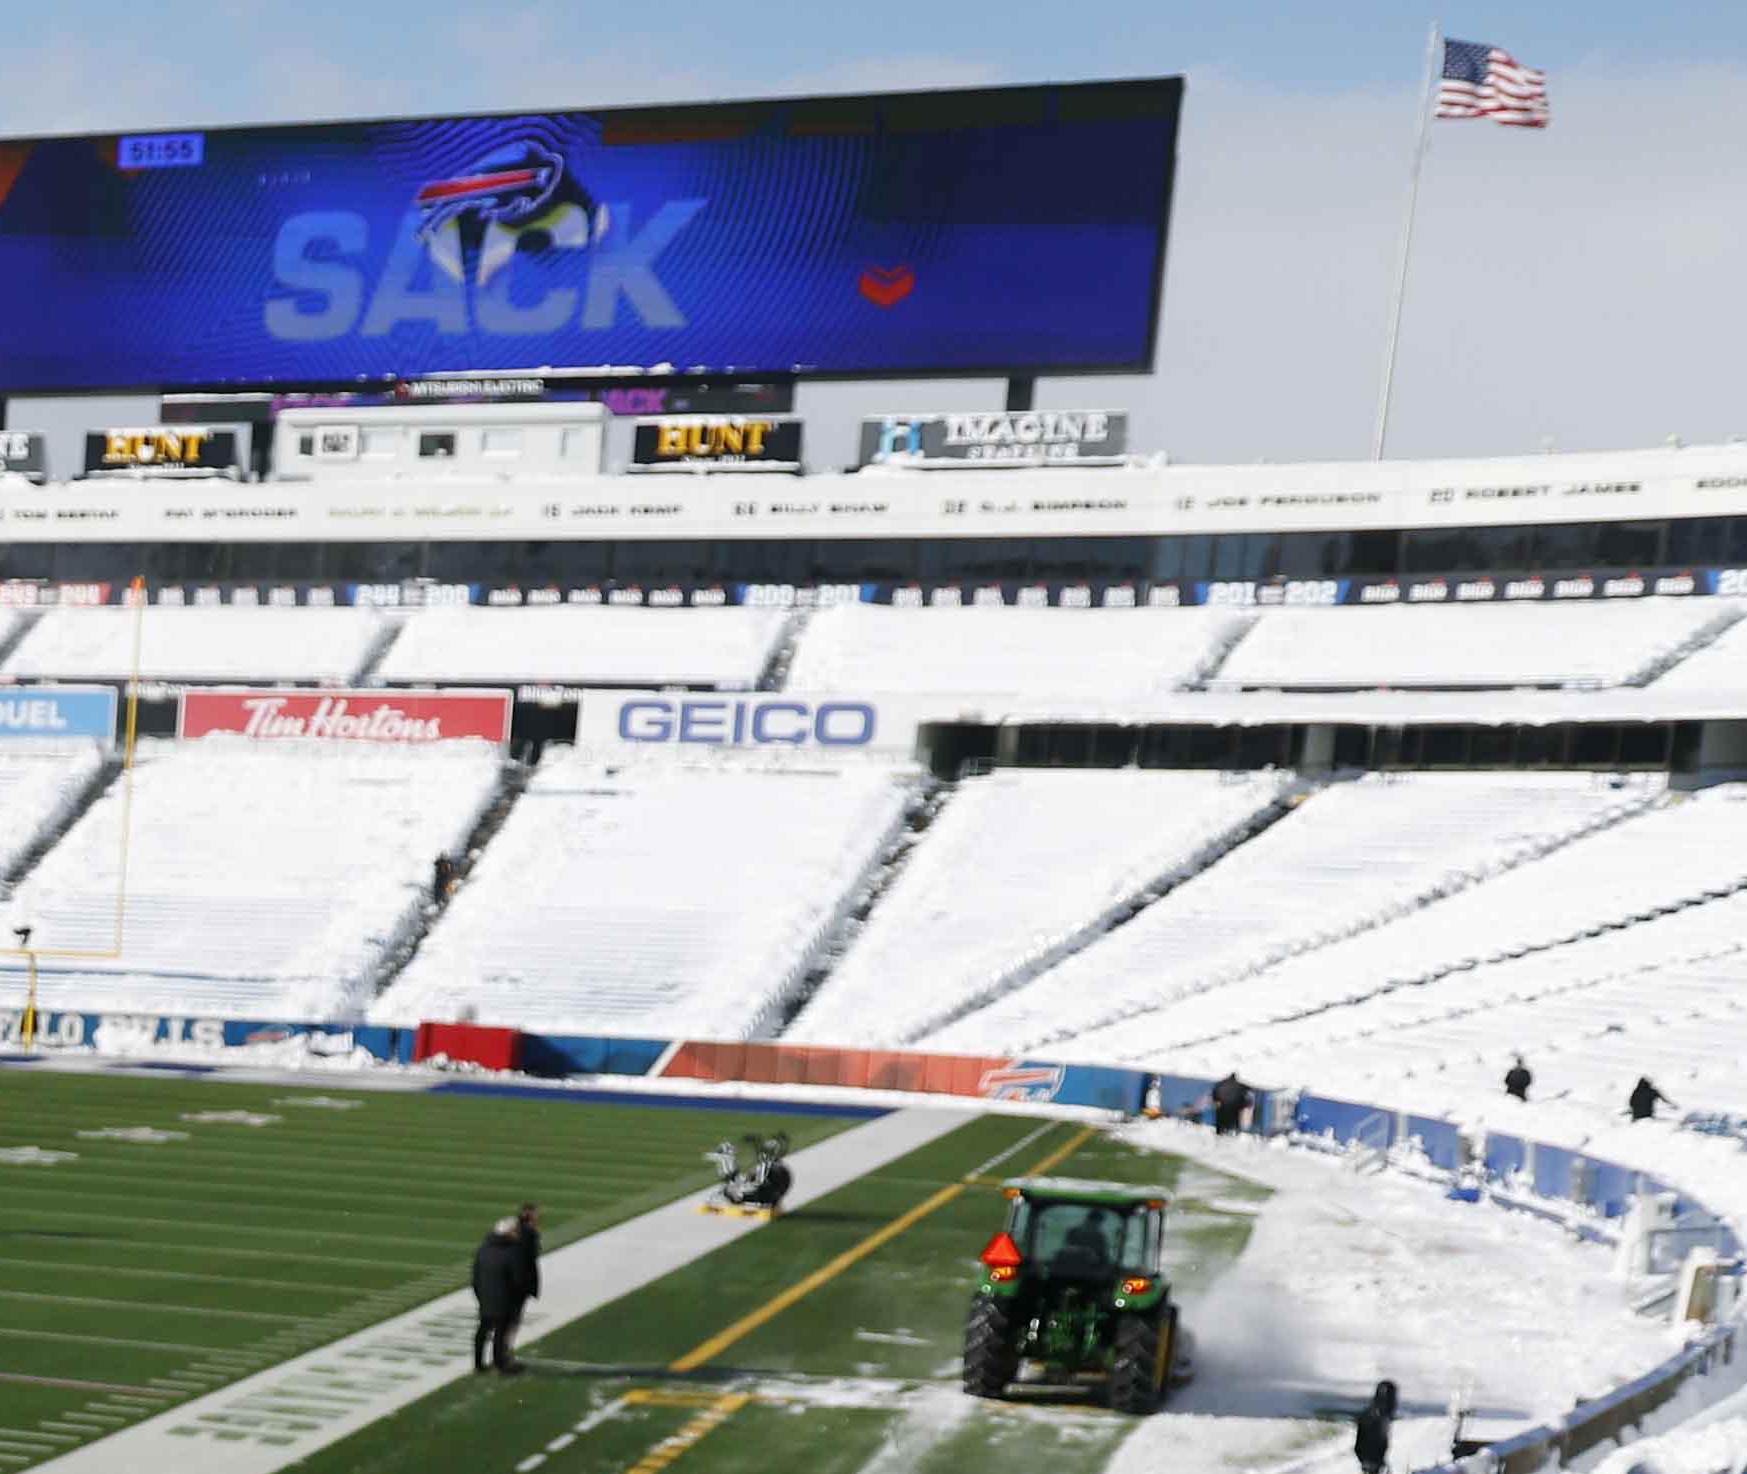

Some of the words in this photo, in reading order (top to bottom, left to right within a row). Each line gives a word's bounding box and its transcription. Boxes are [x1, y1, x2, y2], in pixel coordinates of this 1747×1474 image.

[129, 138, 194, 161] 51:55
[263, 196, 706, 341] SACK
[657, 421, 769, 455] HUNT
[944, 414, 1110, 443] IMAGINE
[105, 431, 204, 463] HUNT
[1205, 580, 1257, 605] 201
[1284, 579, 1338, 605] 202
[242, 697, 307, 738] Tim
[308, 694, 442, 739] Hortons
[618, 700, 876, 746] GEICO
